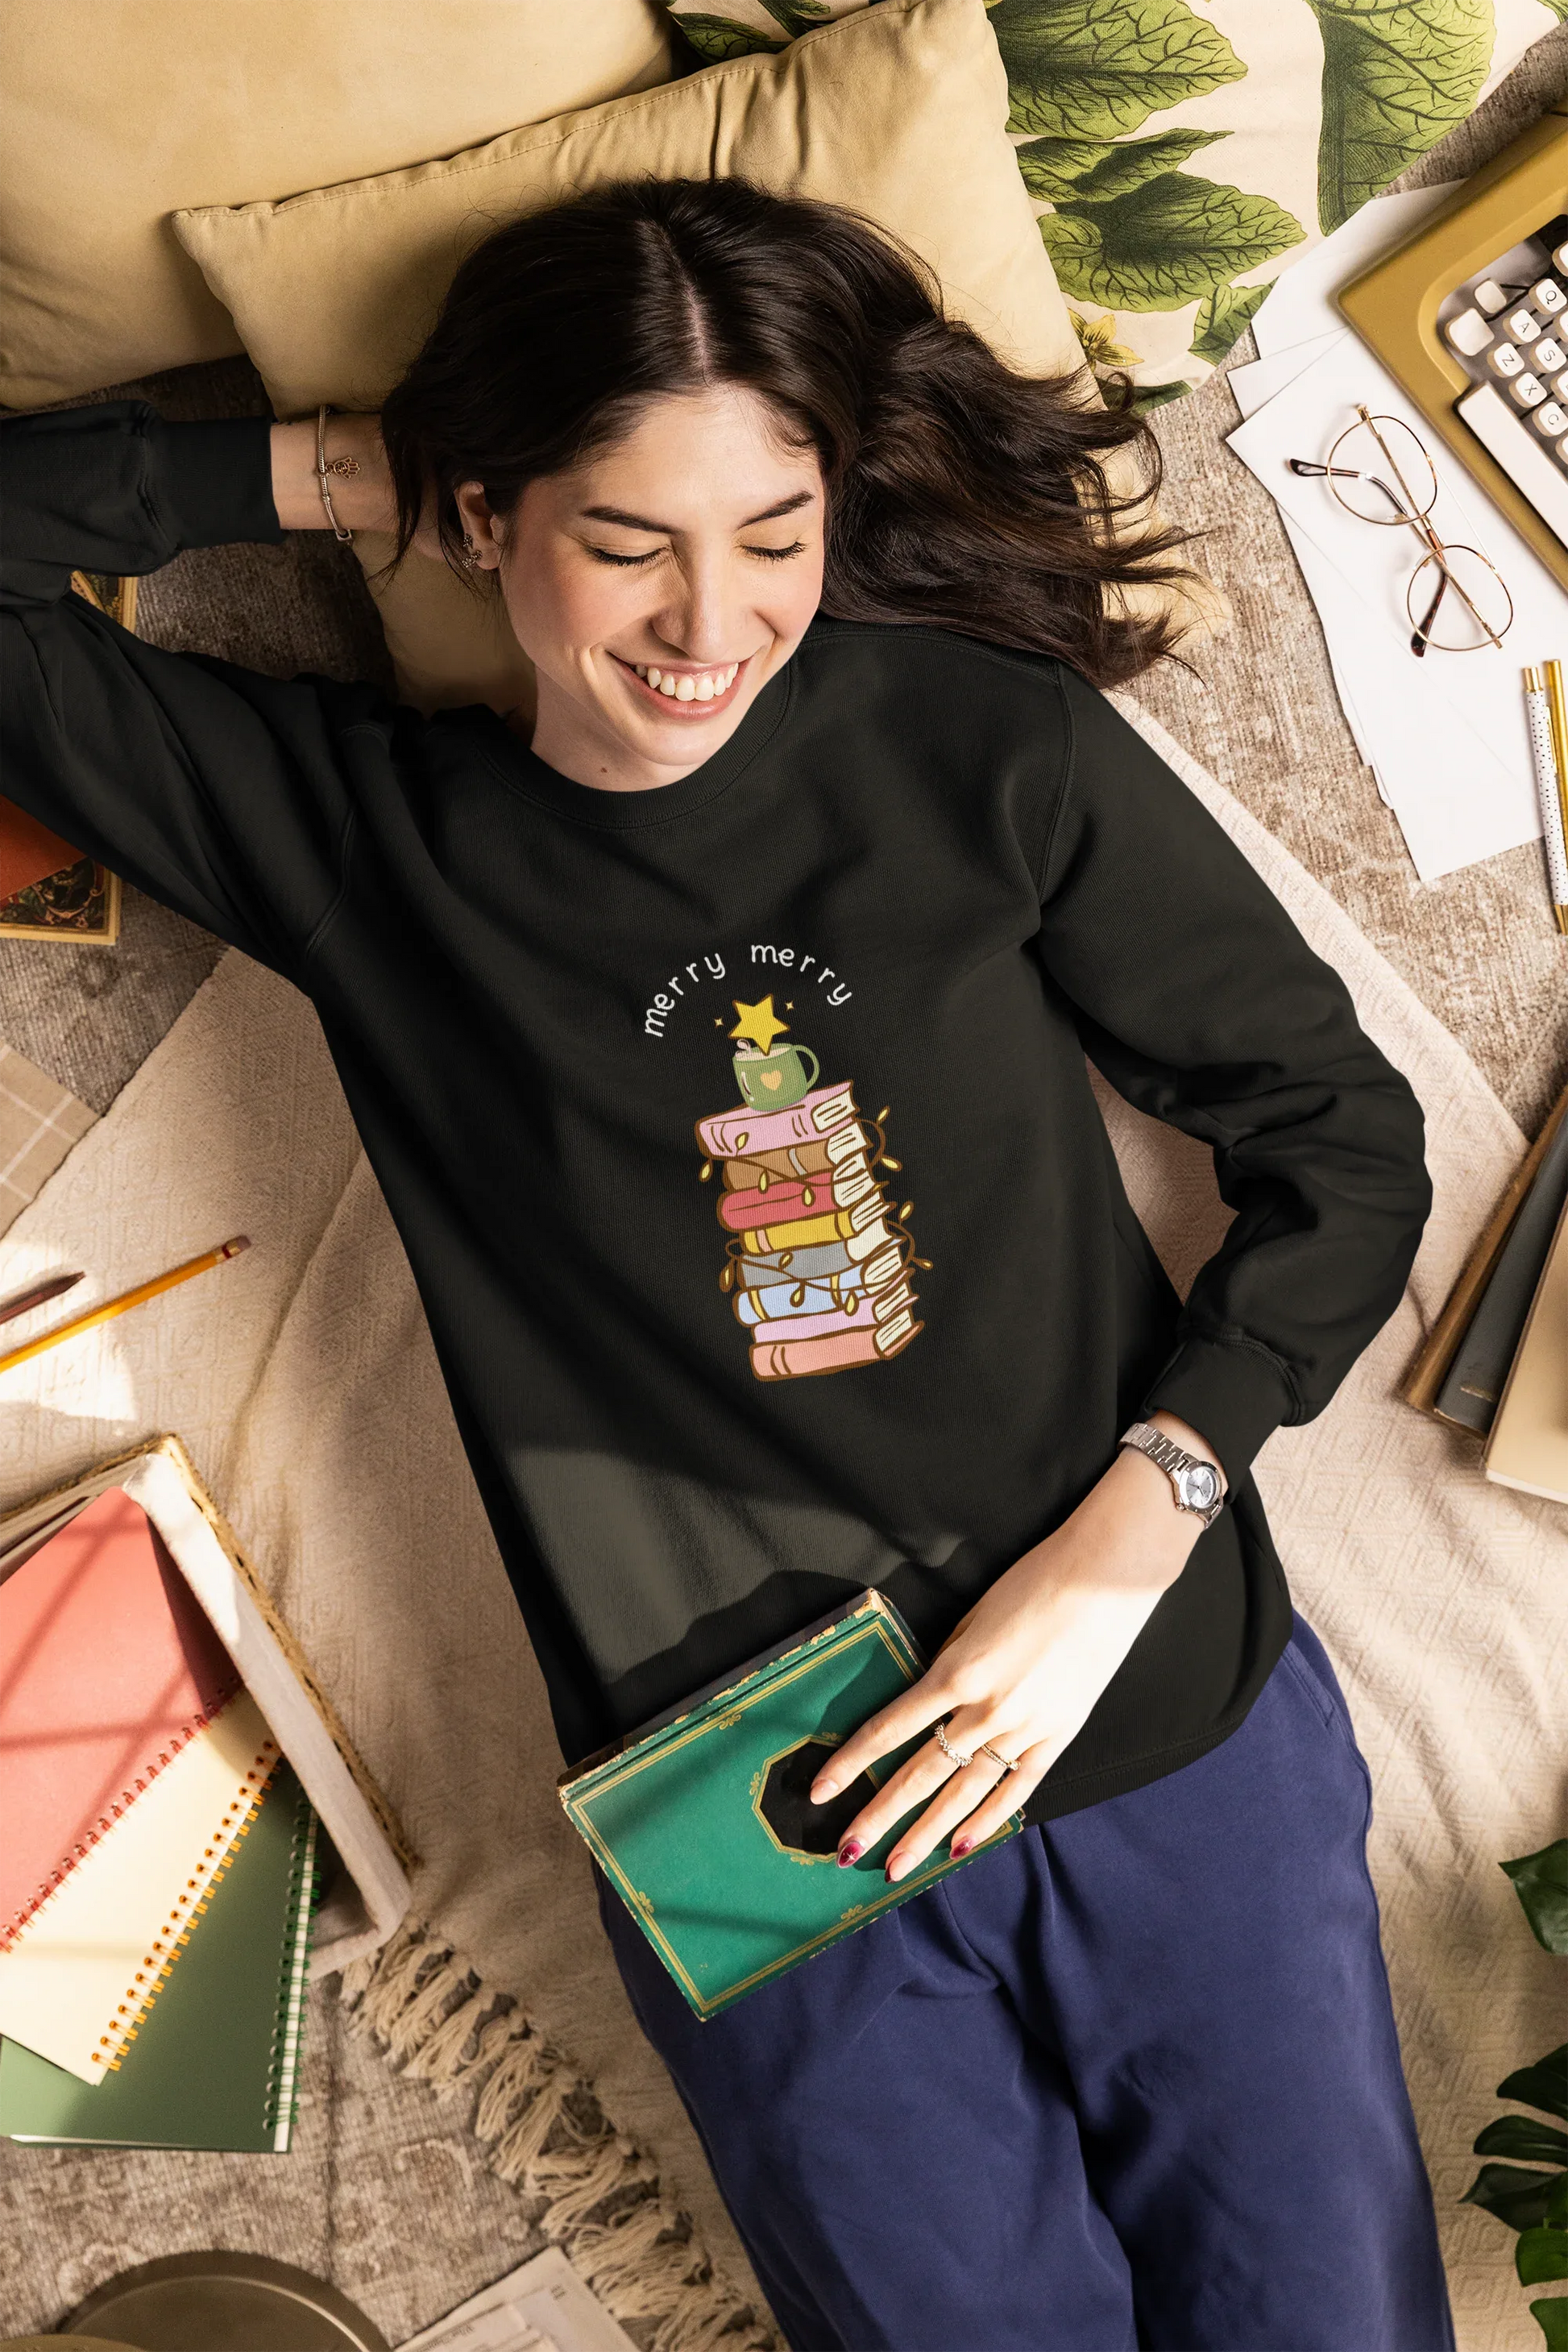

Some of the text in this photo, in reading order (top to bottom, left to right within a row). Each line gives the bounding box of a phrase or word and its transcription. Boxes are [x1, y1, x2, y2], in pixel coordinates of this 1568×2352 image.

[1545, 291, 1557, 305] Q
[1518, 322, 1530, 334] A
[1502, 354, 1515, 367] Z
[1544, 350, 1556, 362] S
[1524, 384, 1537, 396] X
[1548, 413, 1559, 425] C
[644, 944, 852, 1038] merry merry
